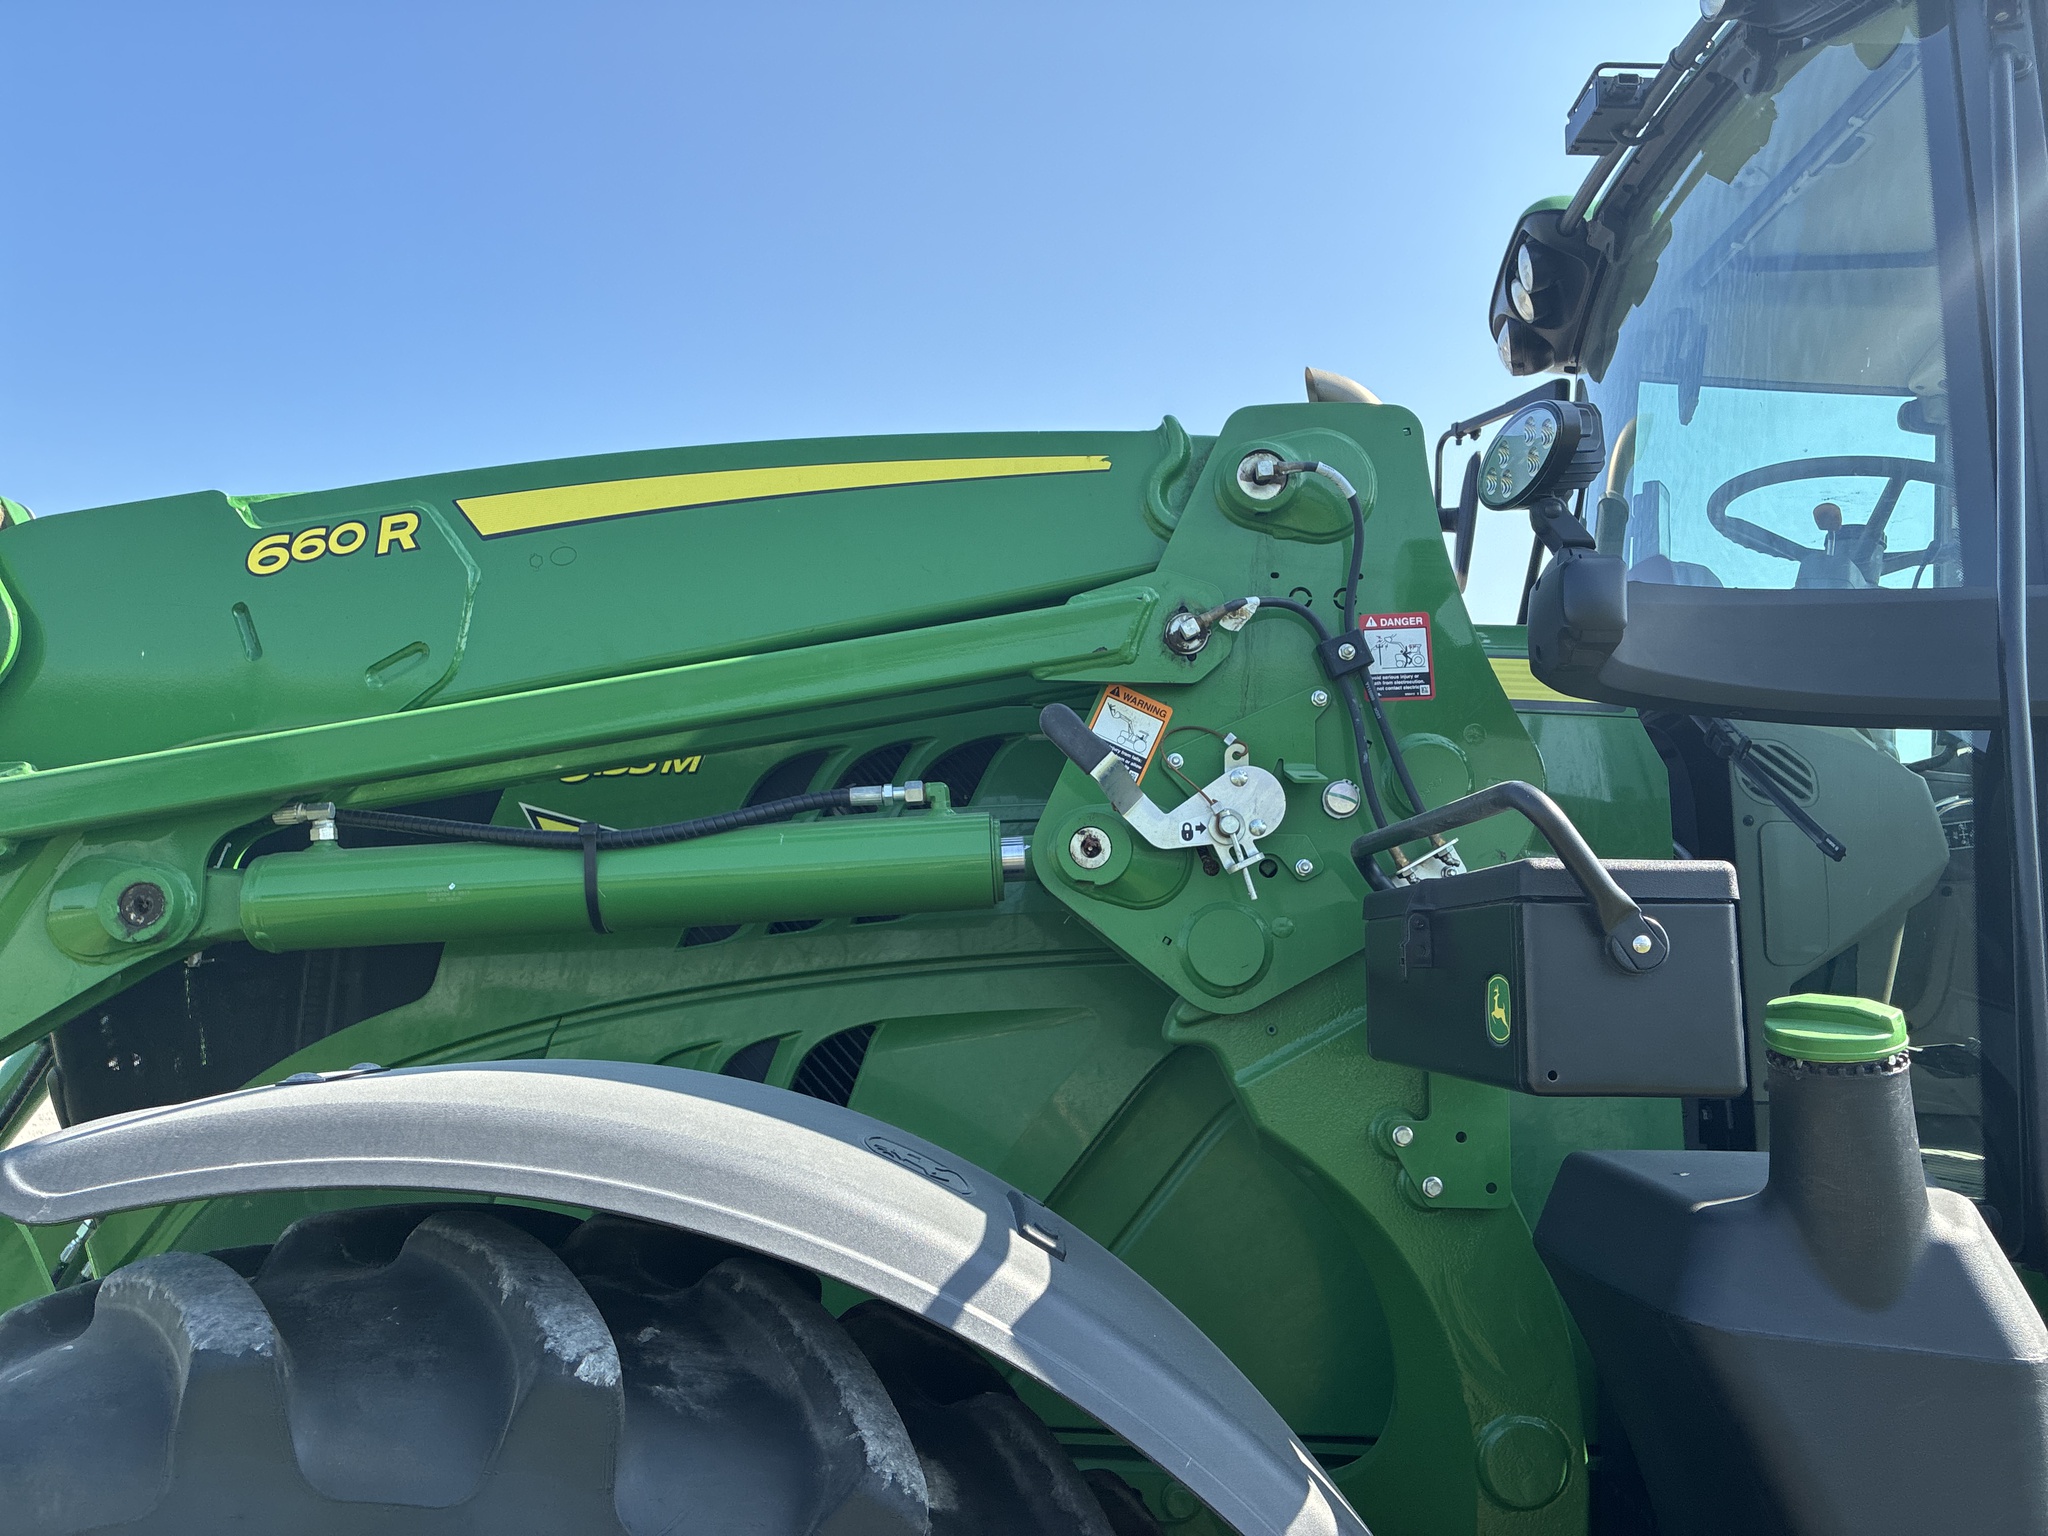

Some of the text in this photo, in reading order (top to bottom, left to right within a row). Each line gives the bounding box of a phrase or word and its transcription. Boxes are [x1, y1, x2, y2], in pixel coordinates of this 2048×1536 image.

[245, 510, 421, 577] 660 R
[1380, 617, 1423, 627] DANGER
[1123, 692, 1167, 718] WARNING
[1121, 750, 1132, 758] from
